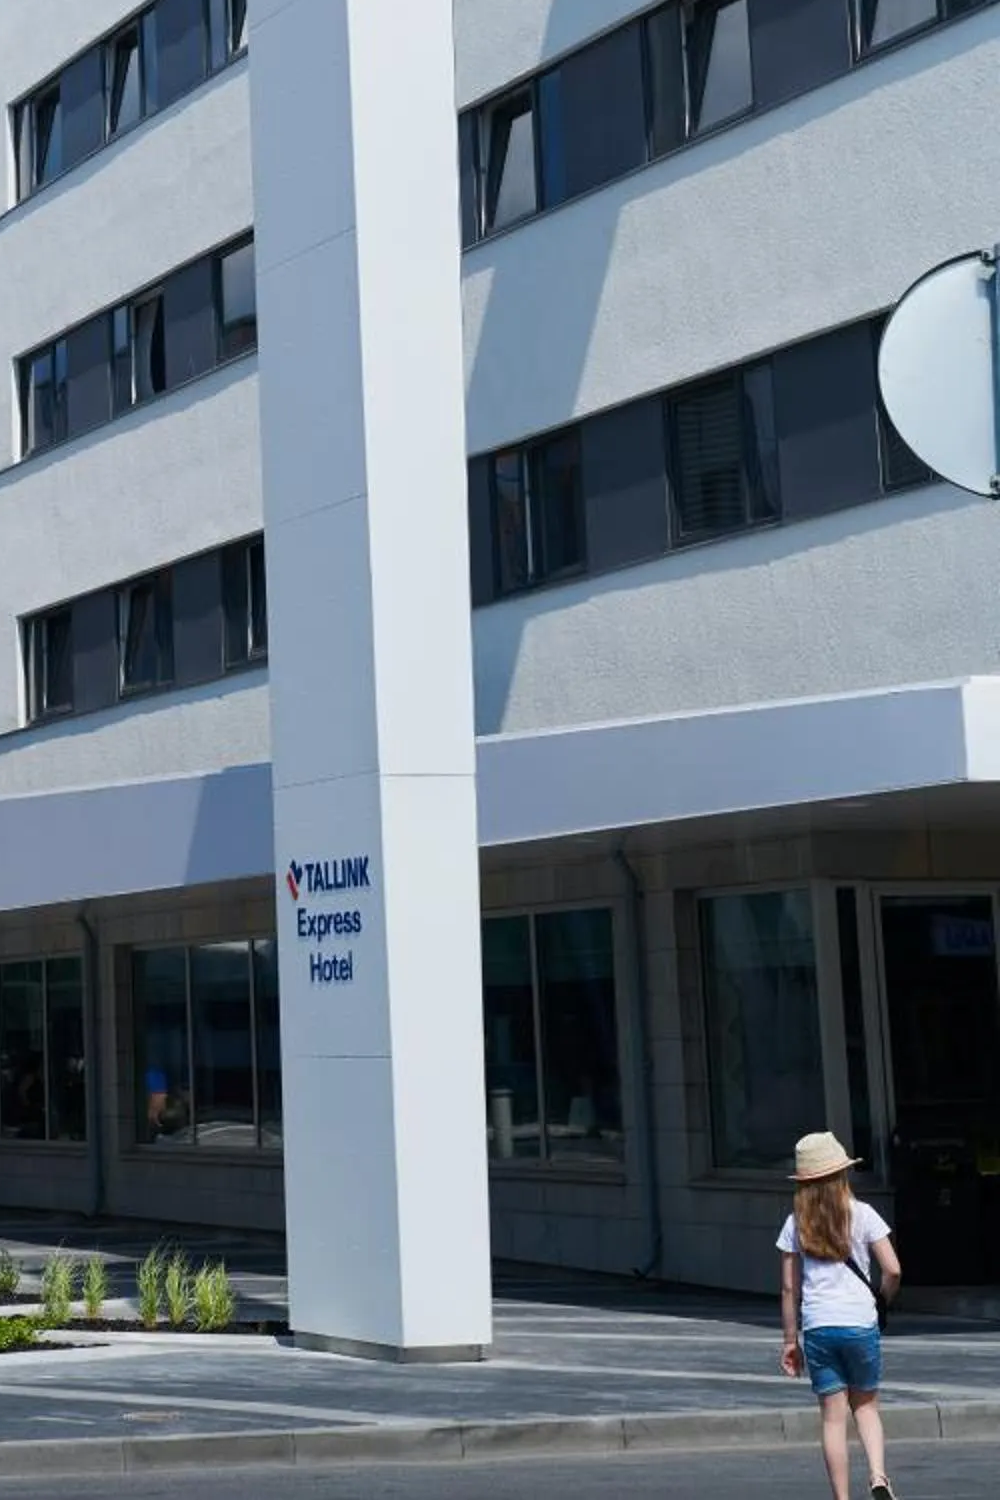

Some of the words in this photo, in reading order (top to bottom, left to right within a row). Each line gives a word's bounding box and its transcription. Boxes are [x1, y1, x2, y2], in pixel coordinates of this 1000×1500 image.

[304, 855, 371, 892] TALLINK
[297, 907, 362, 942] Express
[309, 950, 353, 983] Hotel
